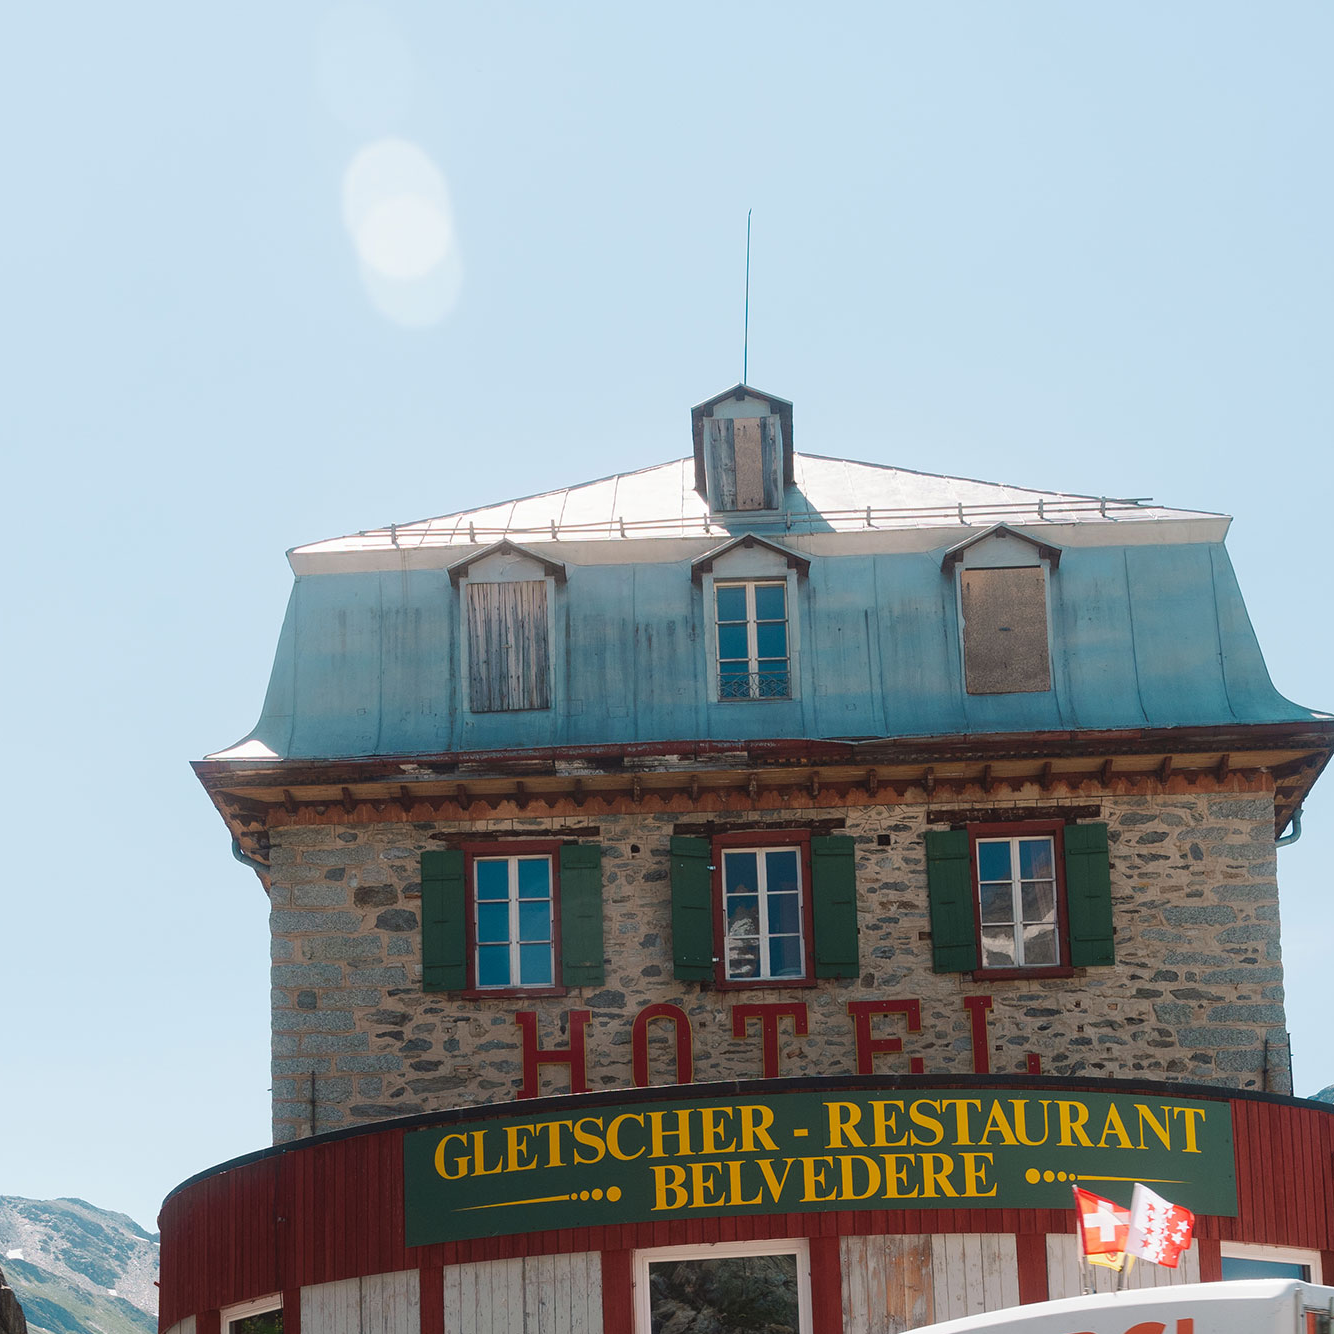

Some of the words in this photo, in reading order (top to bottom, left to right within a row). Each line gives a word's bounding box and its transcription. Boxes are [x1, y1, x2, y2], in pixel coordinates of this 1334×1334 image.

[515, 996, 1041, 1100] HOTEL
[434, 1104, 780, 1180] GLETSCHER
[822, 1099, 1206, 1154] RESTAURANT
[650, 1152, 998, 1211] BELVEDERE
